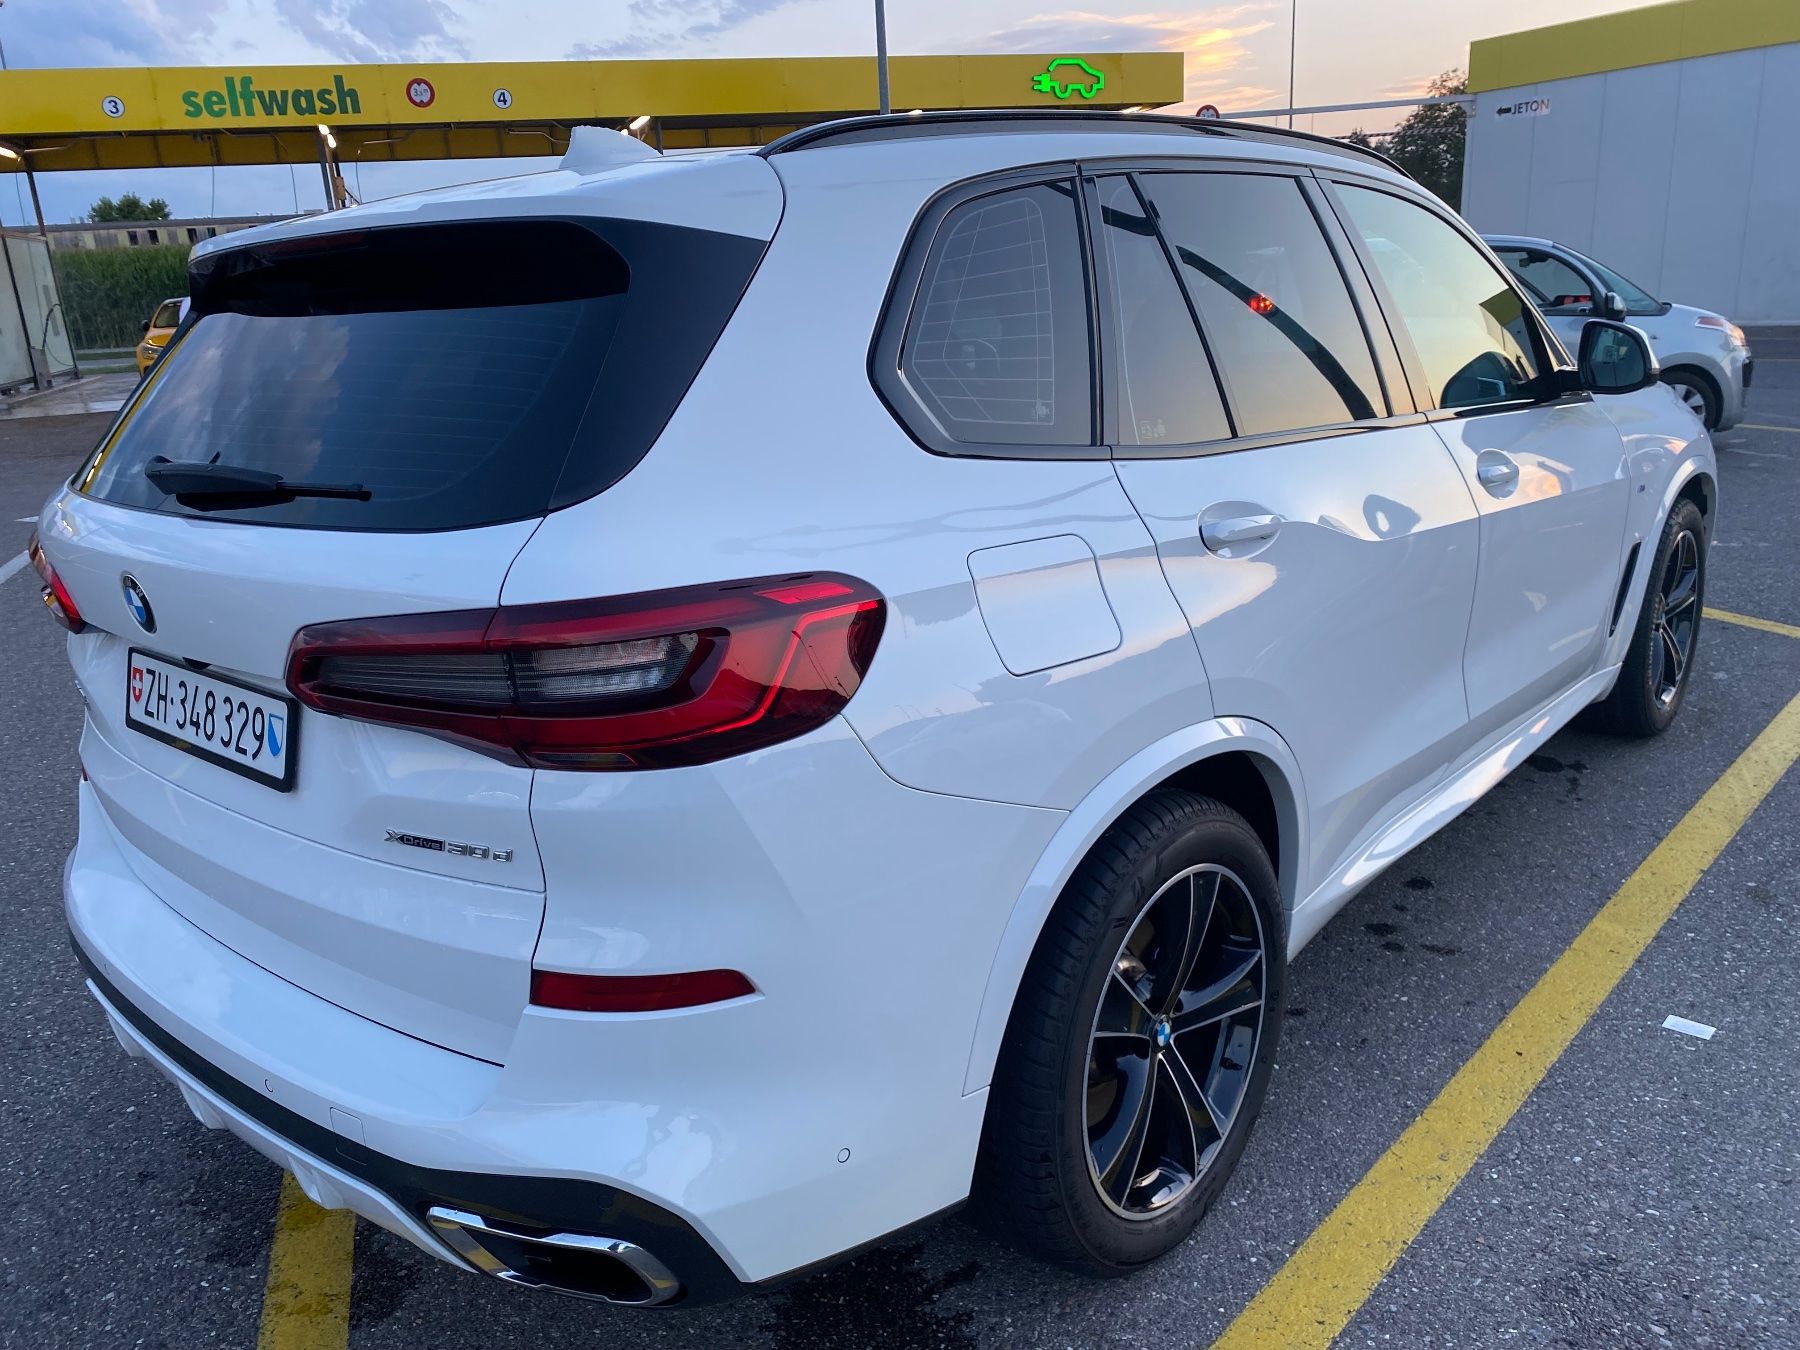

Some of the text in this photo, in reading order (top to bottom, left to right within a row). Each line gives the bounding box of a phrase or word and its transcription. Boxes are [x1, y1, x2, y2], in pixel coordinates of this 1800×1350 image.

[182, 74, 361, 118] selfwash
[497, 91, 508, 106] 4
[108, 99, 120, 115] 3
[1511, 98, 1550, 115] JETON
